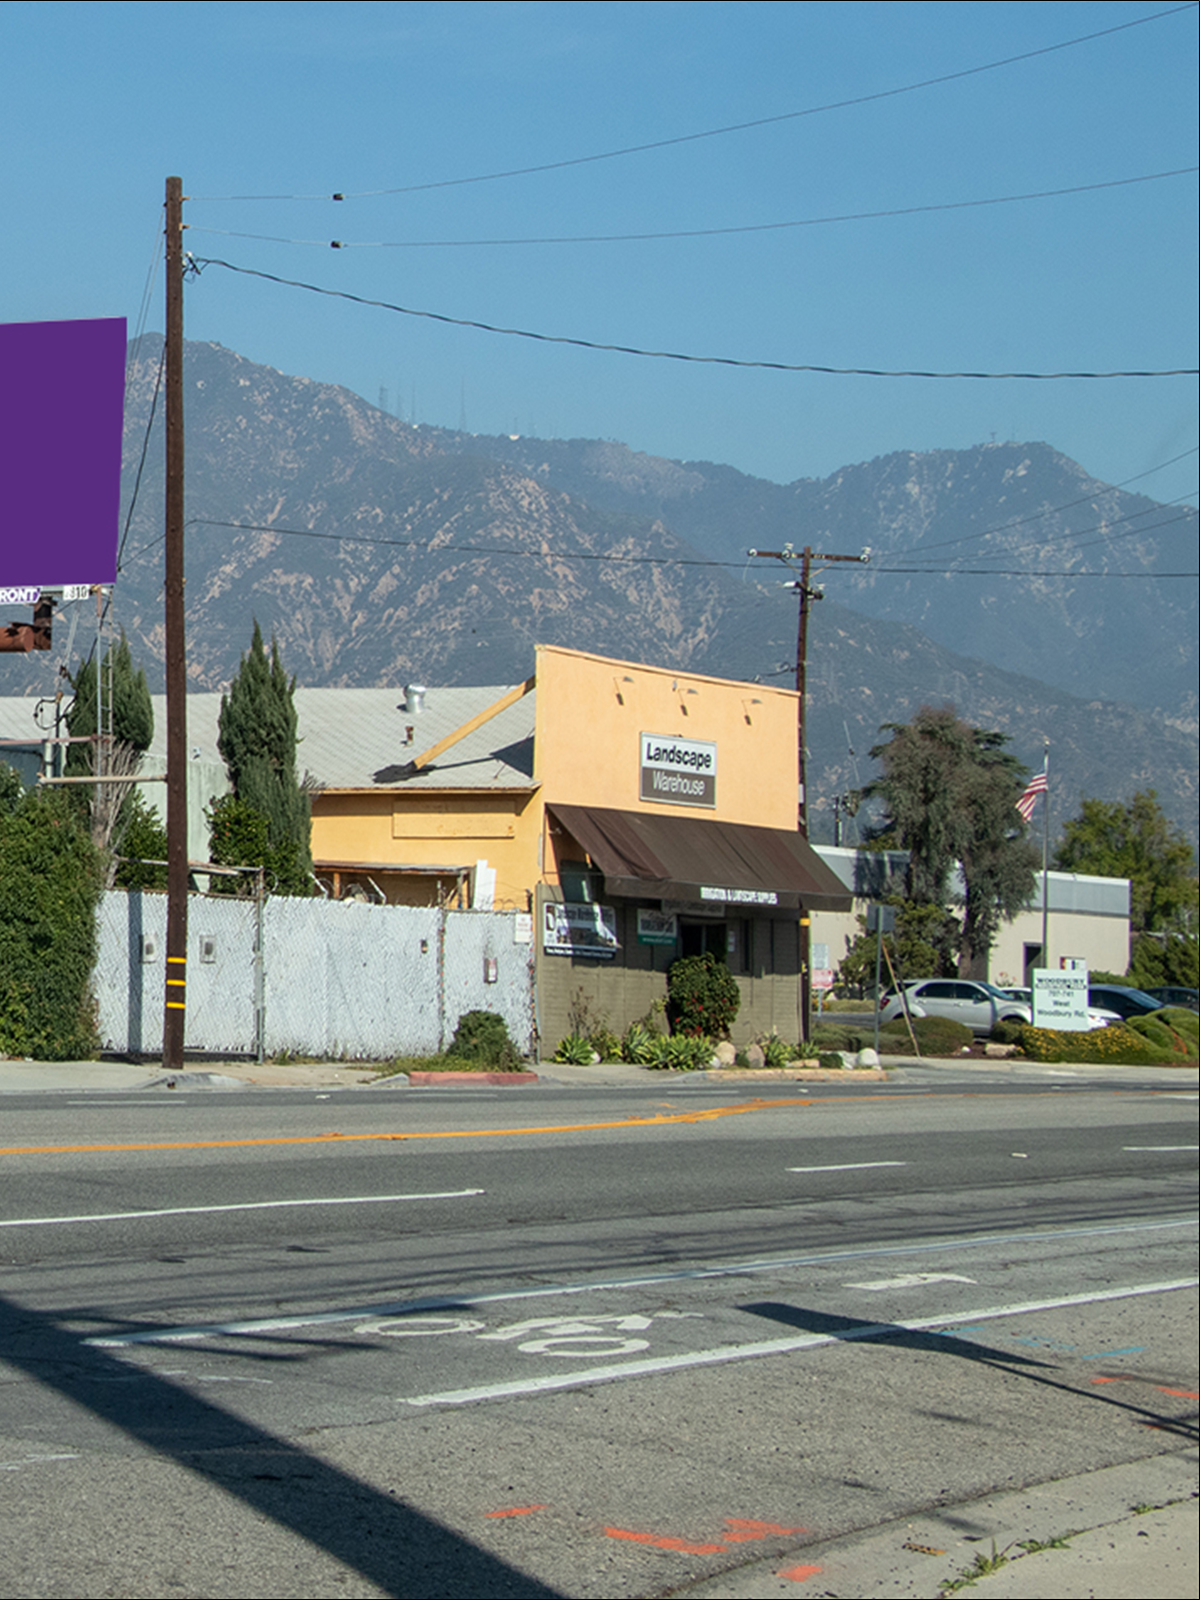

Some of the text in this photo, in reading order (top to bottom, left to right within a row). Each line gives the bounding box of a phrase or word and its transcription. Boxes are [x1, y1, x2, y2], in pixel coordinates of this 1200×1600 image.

[646, 742, 712, 770] Landscape
[652, 770, 706, 795] Warehouse
[1037, 1009, 1072, 1018] Woodbury
